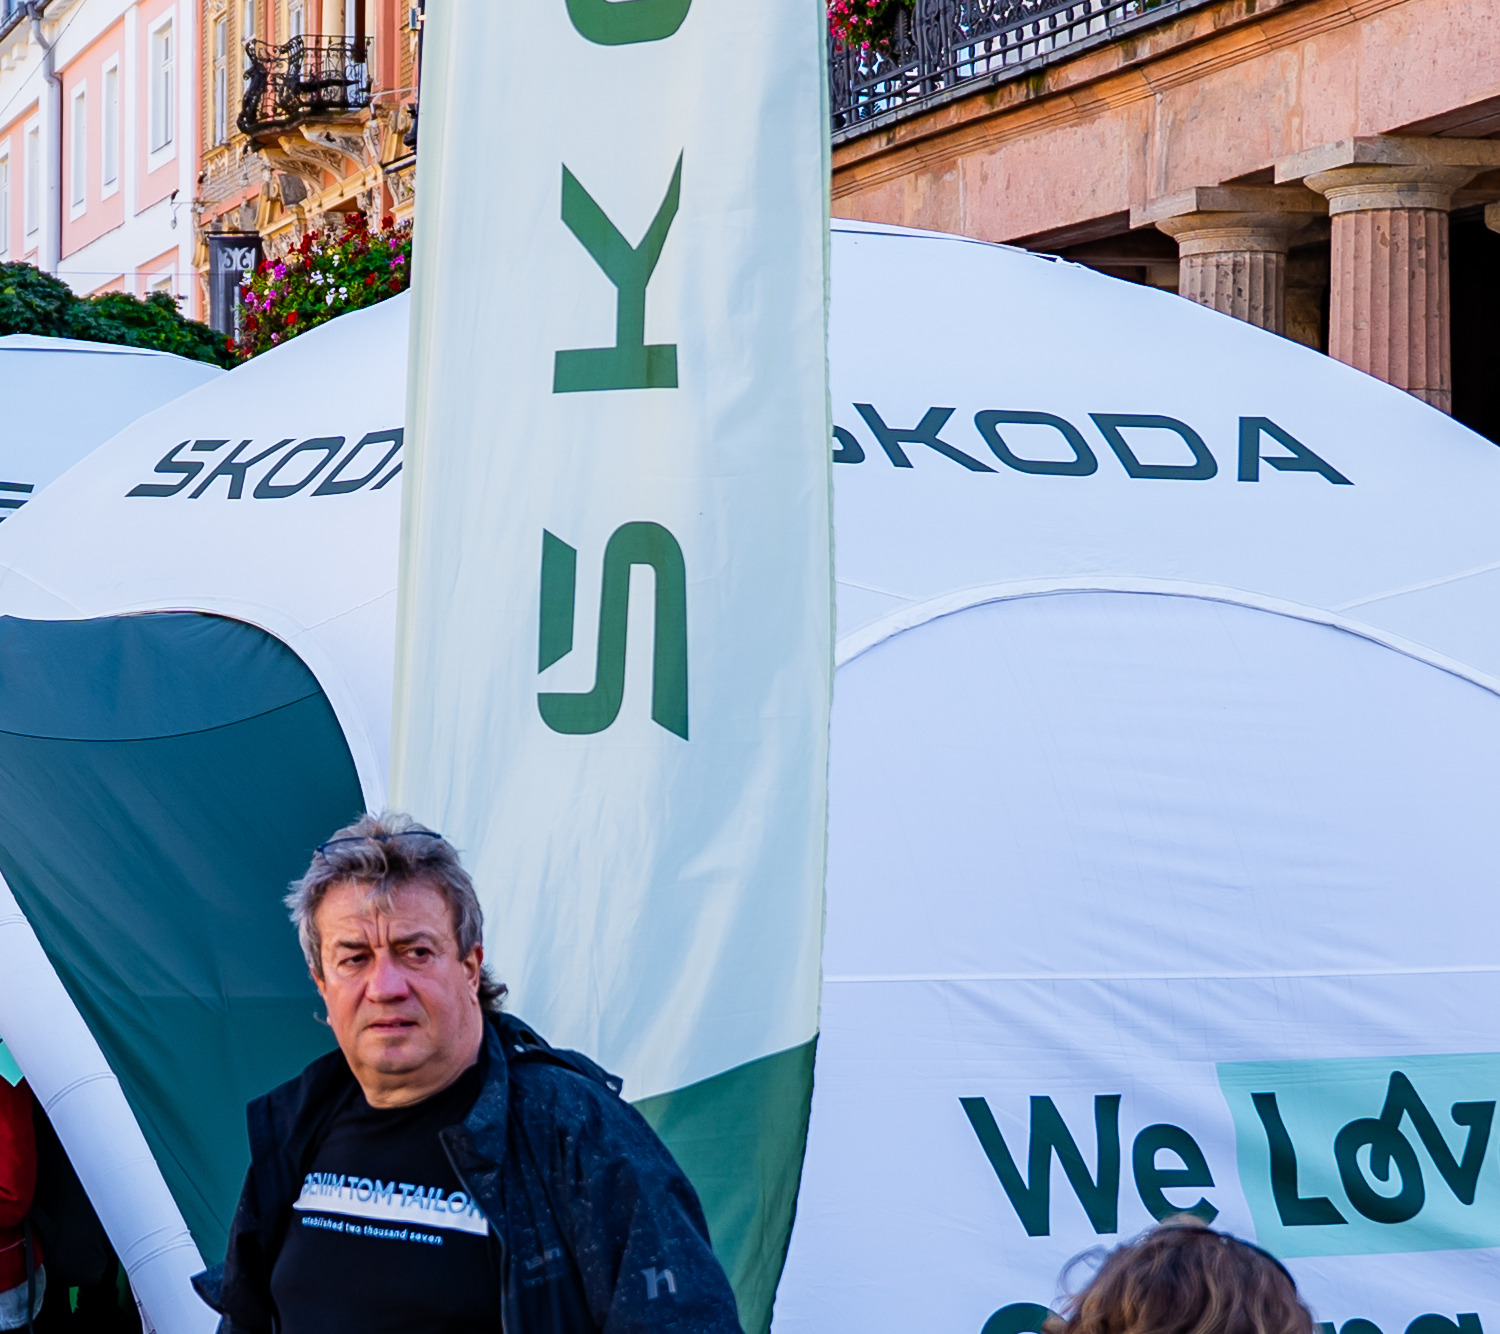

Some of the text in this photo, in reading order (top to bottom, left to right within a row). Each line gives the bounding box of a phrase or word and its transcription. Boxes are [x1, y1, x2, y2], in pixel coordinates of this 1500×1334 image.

[958, 1092, 1220, 1237] We
[301, 1172, 348, 1199] DENIM
[347, 1174, 397, 1205] TOM
[344, 1220, 362, 1235] two
[363, 1223, 408, 1241] thousand
